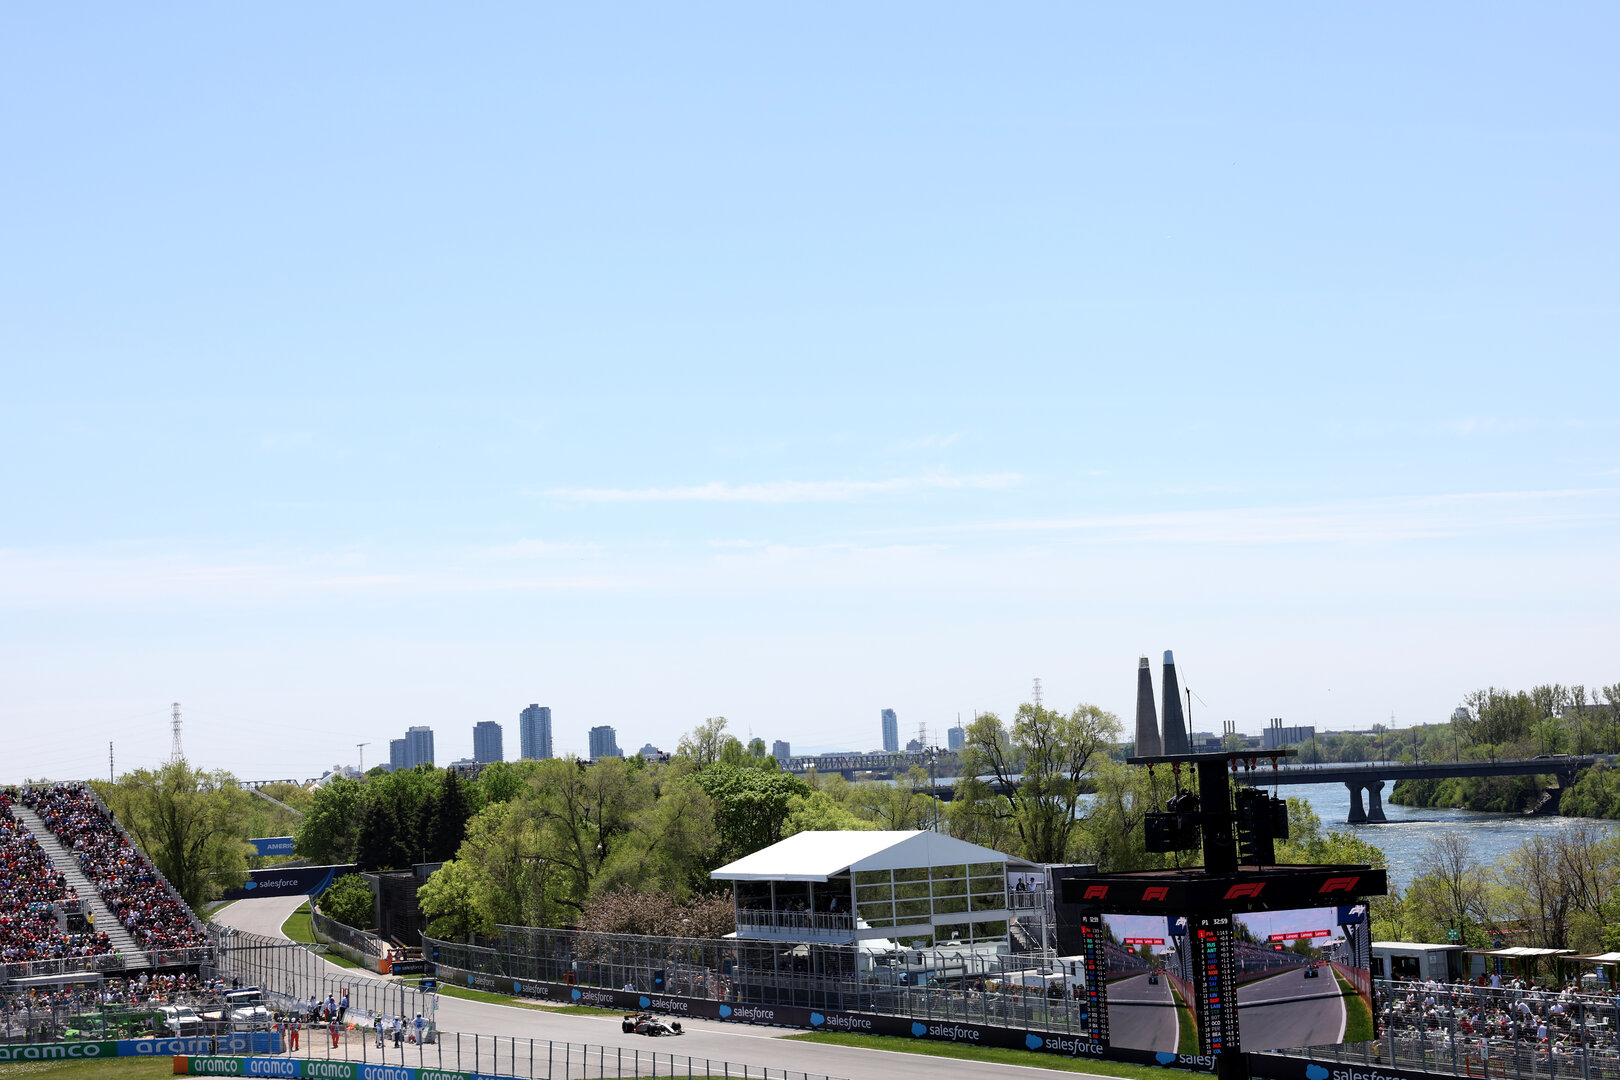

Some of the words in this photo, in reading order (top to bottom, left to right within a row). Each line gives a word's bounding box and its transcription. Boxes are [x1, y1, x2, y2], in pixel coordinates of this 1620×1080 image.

[260, 879, 298, 888] salesforce
[1223, 882, 1265, 899] F1
[1318, 876, 1360, 893] F1
[1083, 885, 1109, 899] F1
[1141, 886, 1169, 901] F1
[522, 984, 548, 995] salesforce
[582, 991, 613, 1003] salesforce
[652, 998, 688, 1011] salesforce
[733, 1006, 774, 1020] salesforce
[826, 1014, 871, 1030] salesforce
[929, 1024, 979, 1040] salesforce
[0, 1044, 100, 1059] aramco
[136, 1039, 246, 1053] aramco
[1046, 1037, 1104, 1055] salesforce
[194, 1059, 238, 1072] aramco
[250, 1060, 294, 1075] aramco
[307, 1062, 351, 1078] aramco
[364, 1067, 408, 1080] aramco
[1333, 1068, 1408, 1080] salesf
